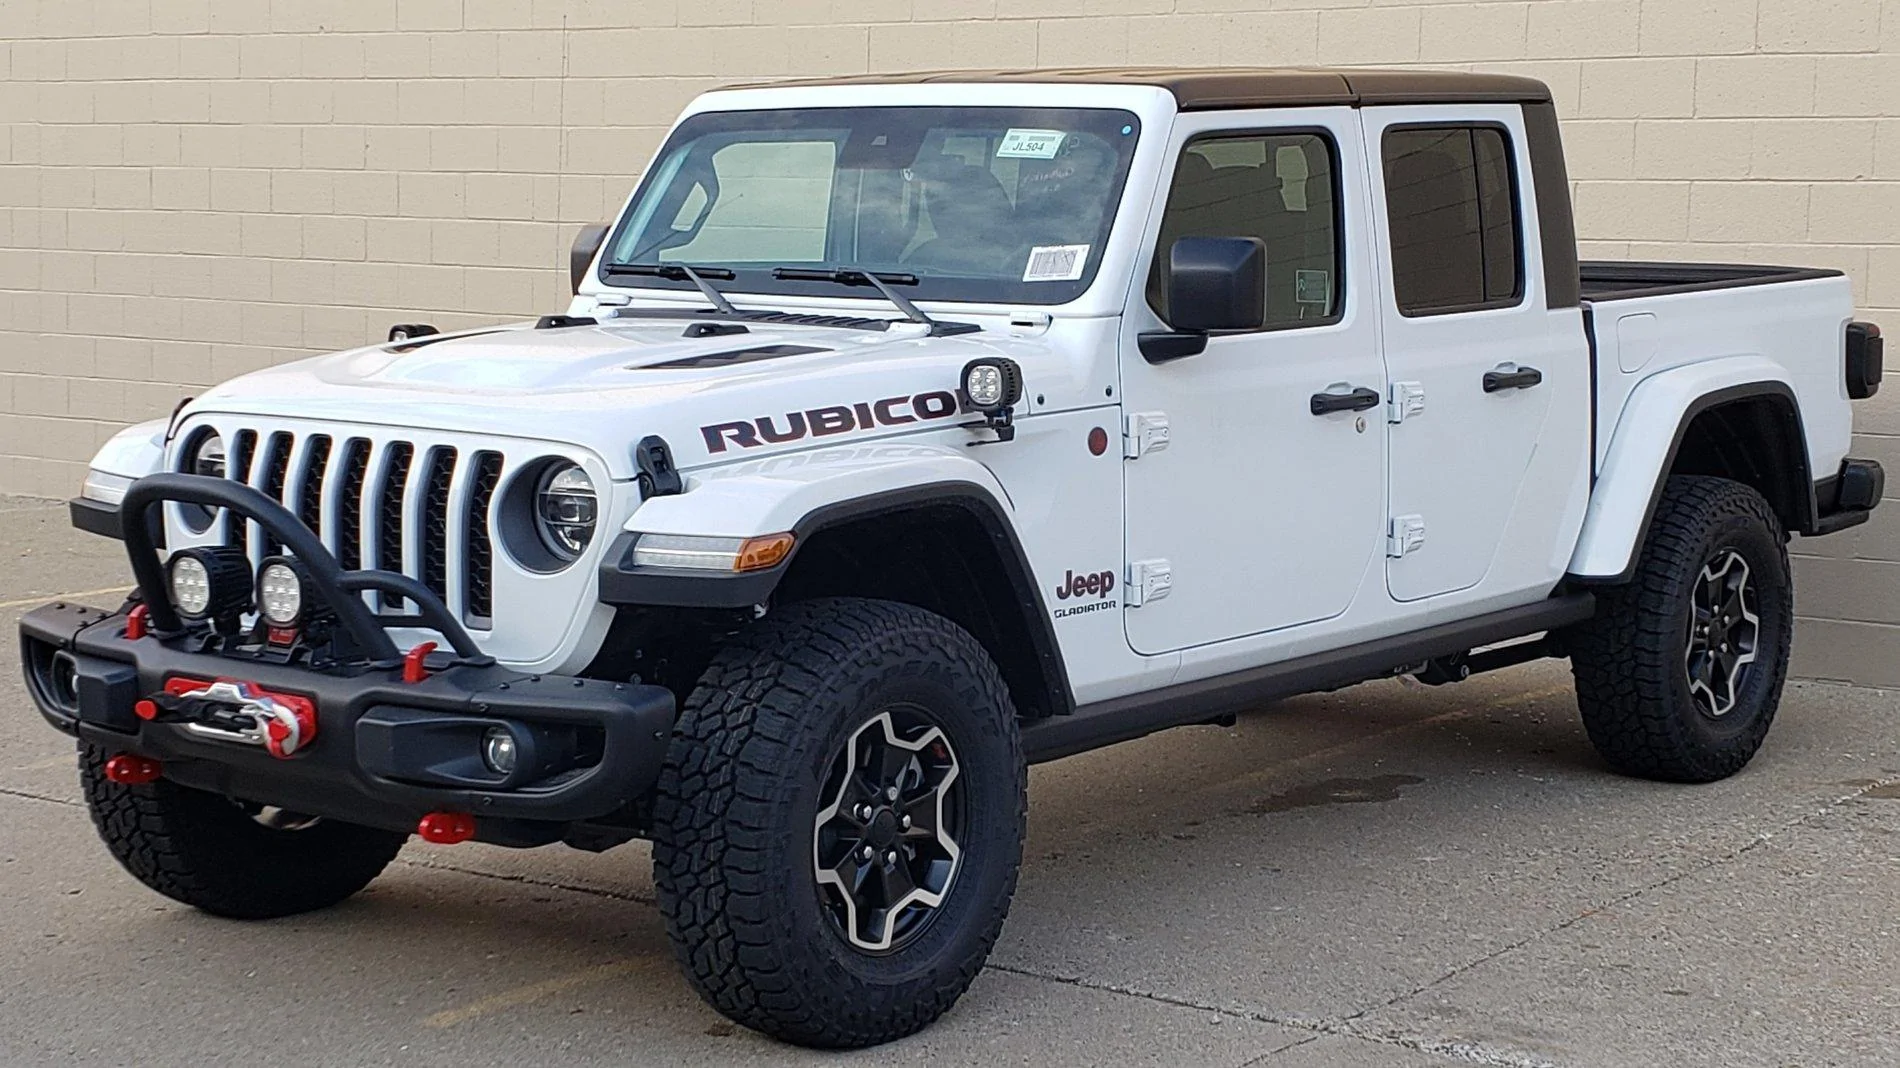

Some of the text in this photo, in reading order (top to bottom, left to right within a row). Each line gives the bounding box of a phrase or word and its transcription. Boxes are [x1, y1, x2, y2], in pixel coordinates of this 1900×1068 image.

[1012, 142, 1045, 152] JL504
[1056, 569, 1115, 600] Jeep
[1054, 600, 1117, 618] GLADIATOR
